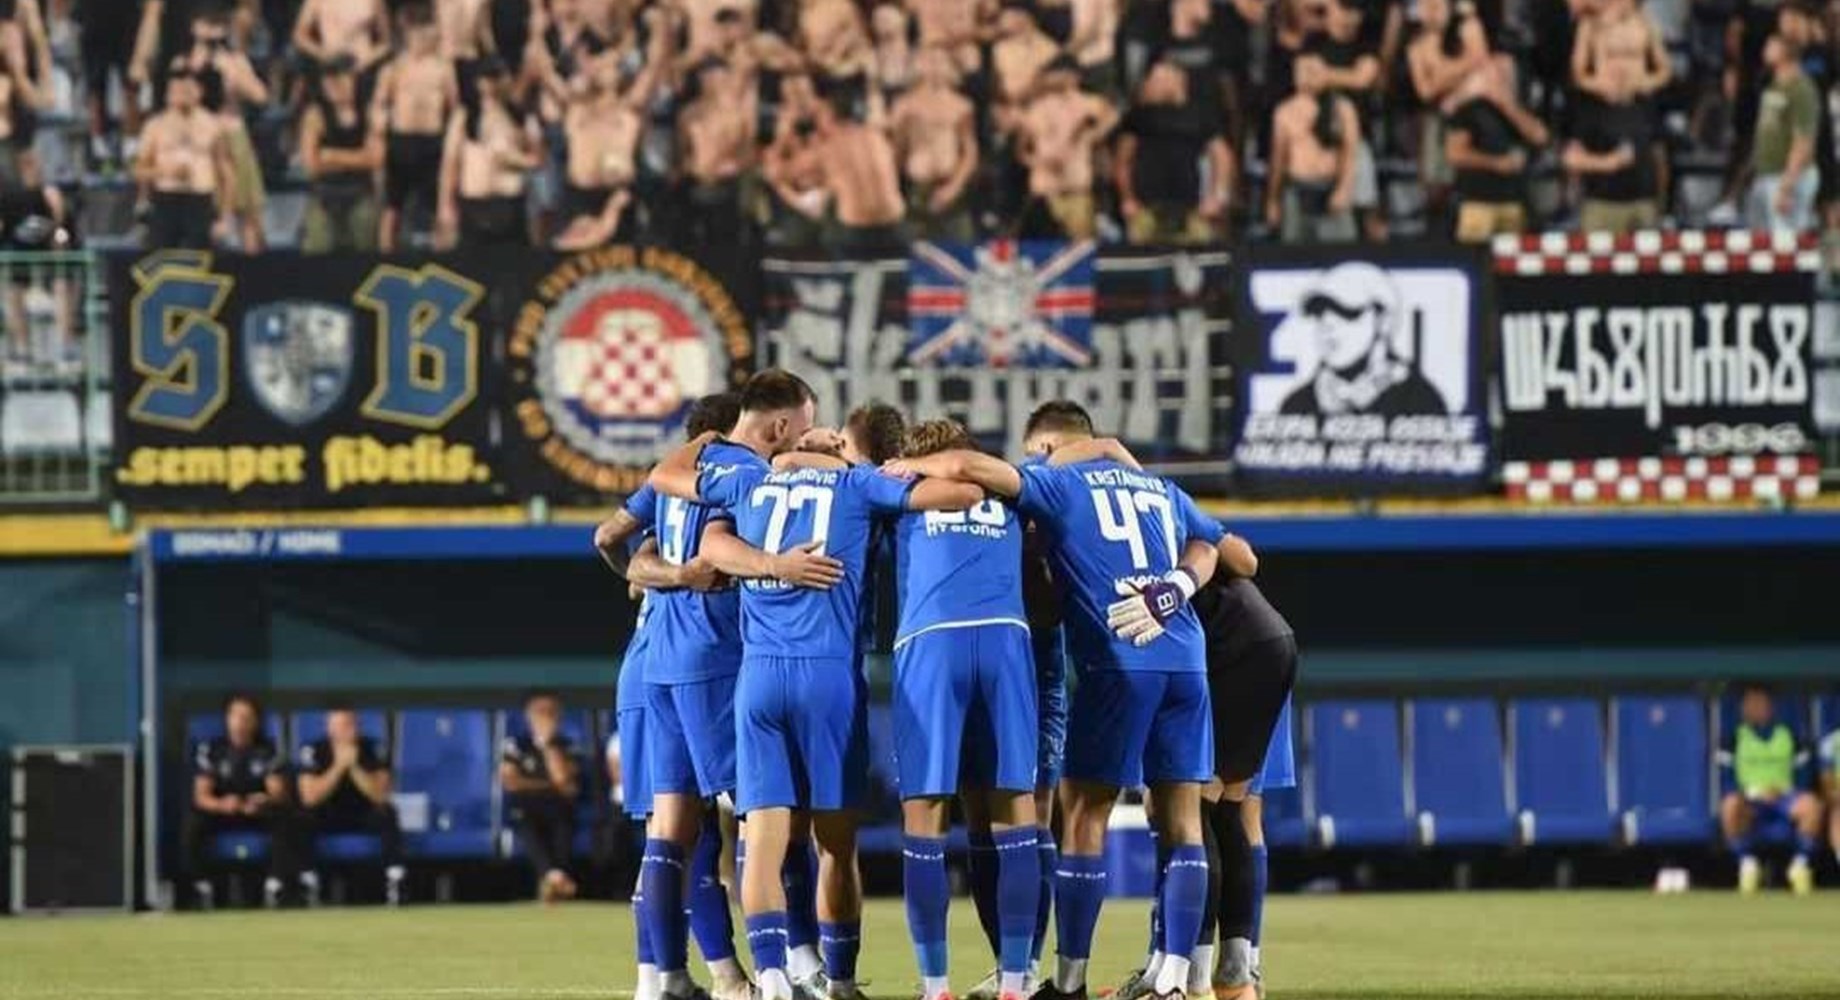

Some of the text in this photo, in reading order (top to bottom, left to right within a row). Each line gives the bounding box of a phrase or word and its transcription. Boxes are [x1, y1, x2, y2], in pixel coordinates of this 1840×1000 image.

[353, 262, 486, 429] B
[751, 485, 835, 557] 77
[1090, 487, 1179, 571] 47
